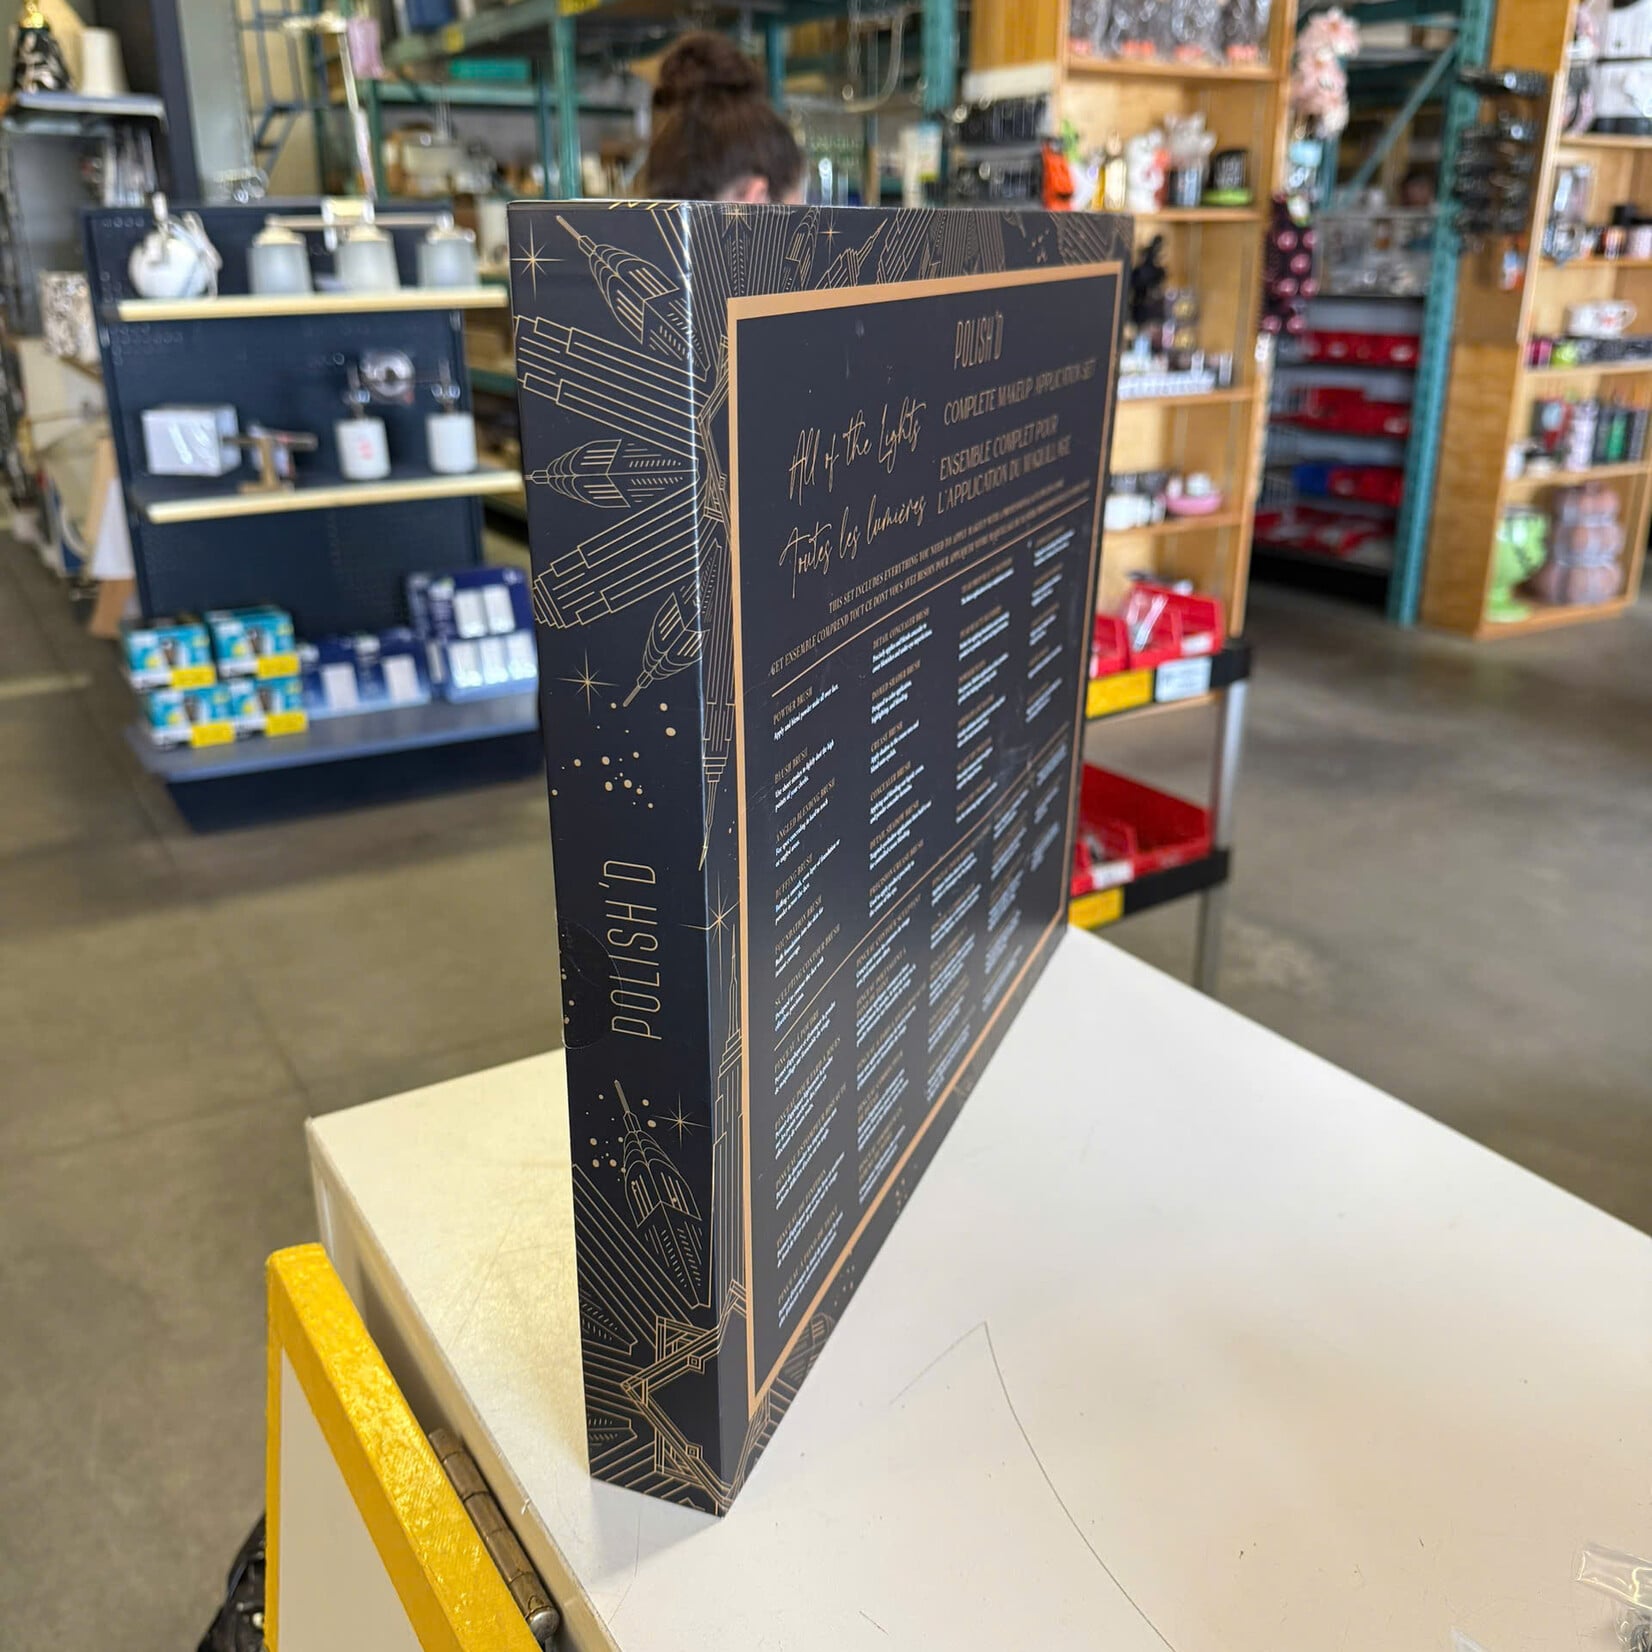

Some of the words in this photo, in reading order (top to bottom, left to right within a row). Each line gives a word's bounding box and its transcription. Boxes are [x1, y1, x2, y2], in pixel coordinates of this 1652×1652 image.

[954, 310, 1004, 370] POLISH'D
[944, 388, 996, 426] COMPLETE
[789, 427, 822, 506] All
[825, 433, 839, 493] of
[843, 409, 873, 467] the
[878, 396, 927, 474] Lights
[939, 440, 992, 482] ENSEMBLE
[992, 422, 1035, 458] COMPLET
[938, 466, 1008, 515] L'APPLICATION
[779, 521, 833, 599] Toutes
[839, 506, 862, 560] les
[829, 596, 842, 613] THIS
[844, 589, 854, 605] SET
[856, 572, 883, 598] INCLUDES
[598, 860, 663, 1041] POLISH'D
